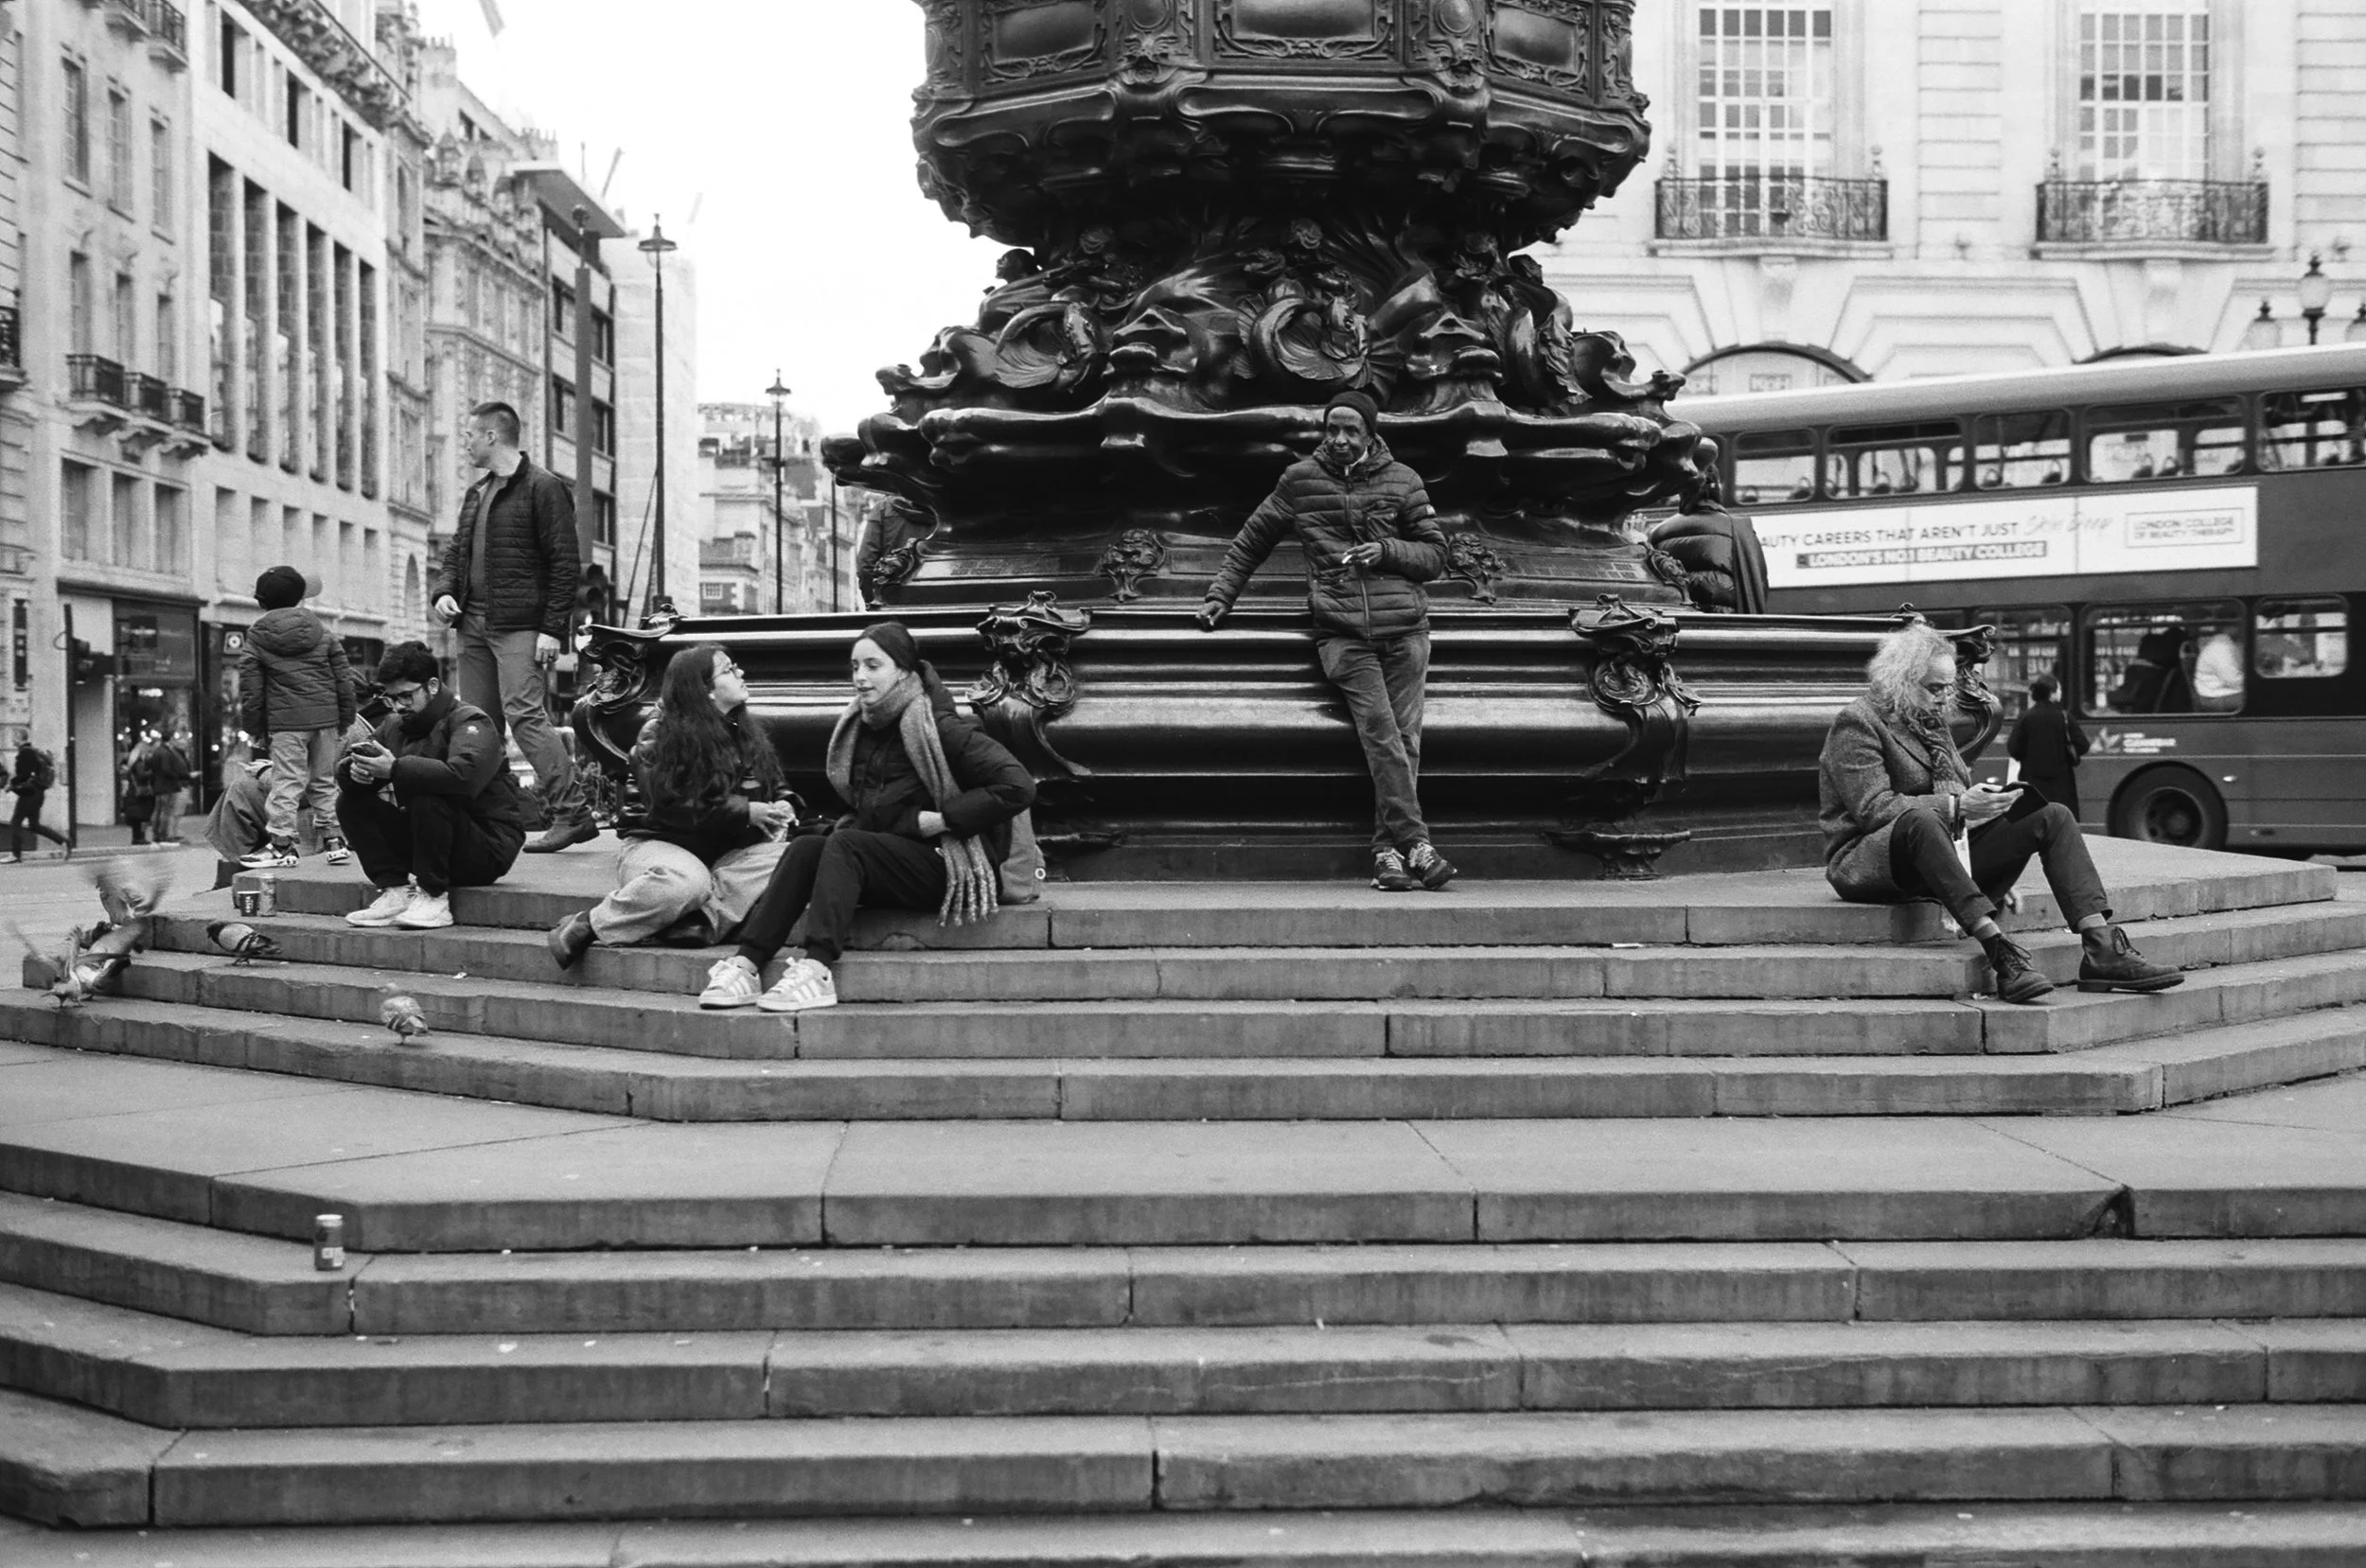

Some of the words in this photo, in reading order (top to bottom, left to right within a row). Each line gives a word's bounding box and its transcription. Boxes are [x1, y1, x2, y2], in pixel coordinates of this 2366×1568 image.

[2133, 520, 2181, 530] LONDON
[2185, 517, 2234, 528] COLLEGE
[1804, 531, 1871, 546] CAREERS
[1877, 527, 1914, 542] THAT
[1919, 524, 1976, 539] AREN'T
[1982, 521, 2019, 537] JUST
